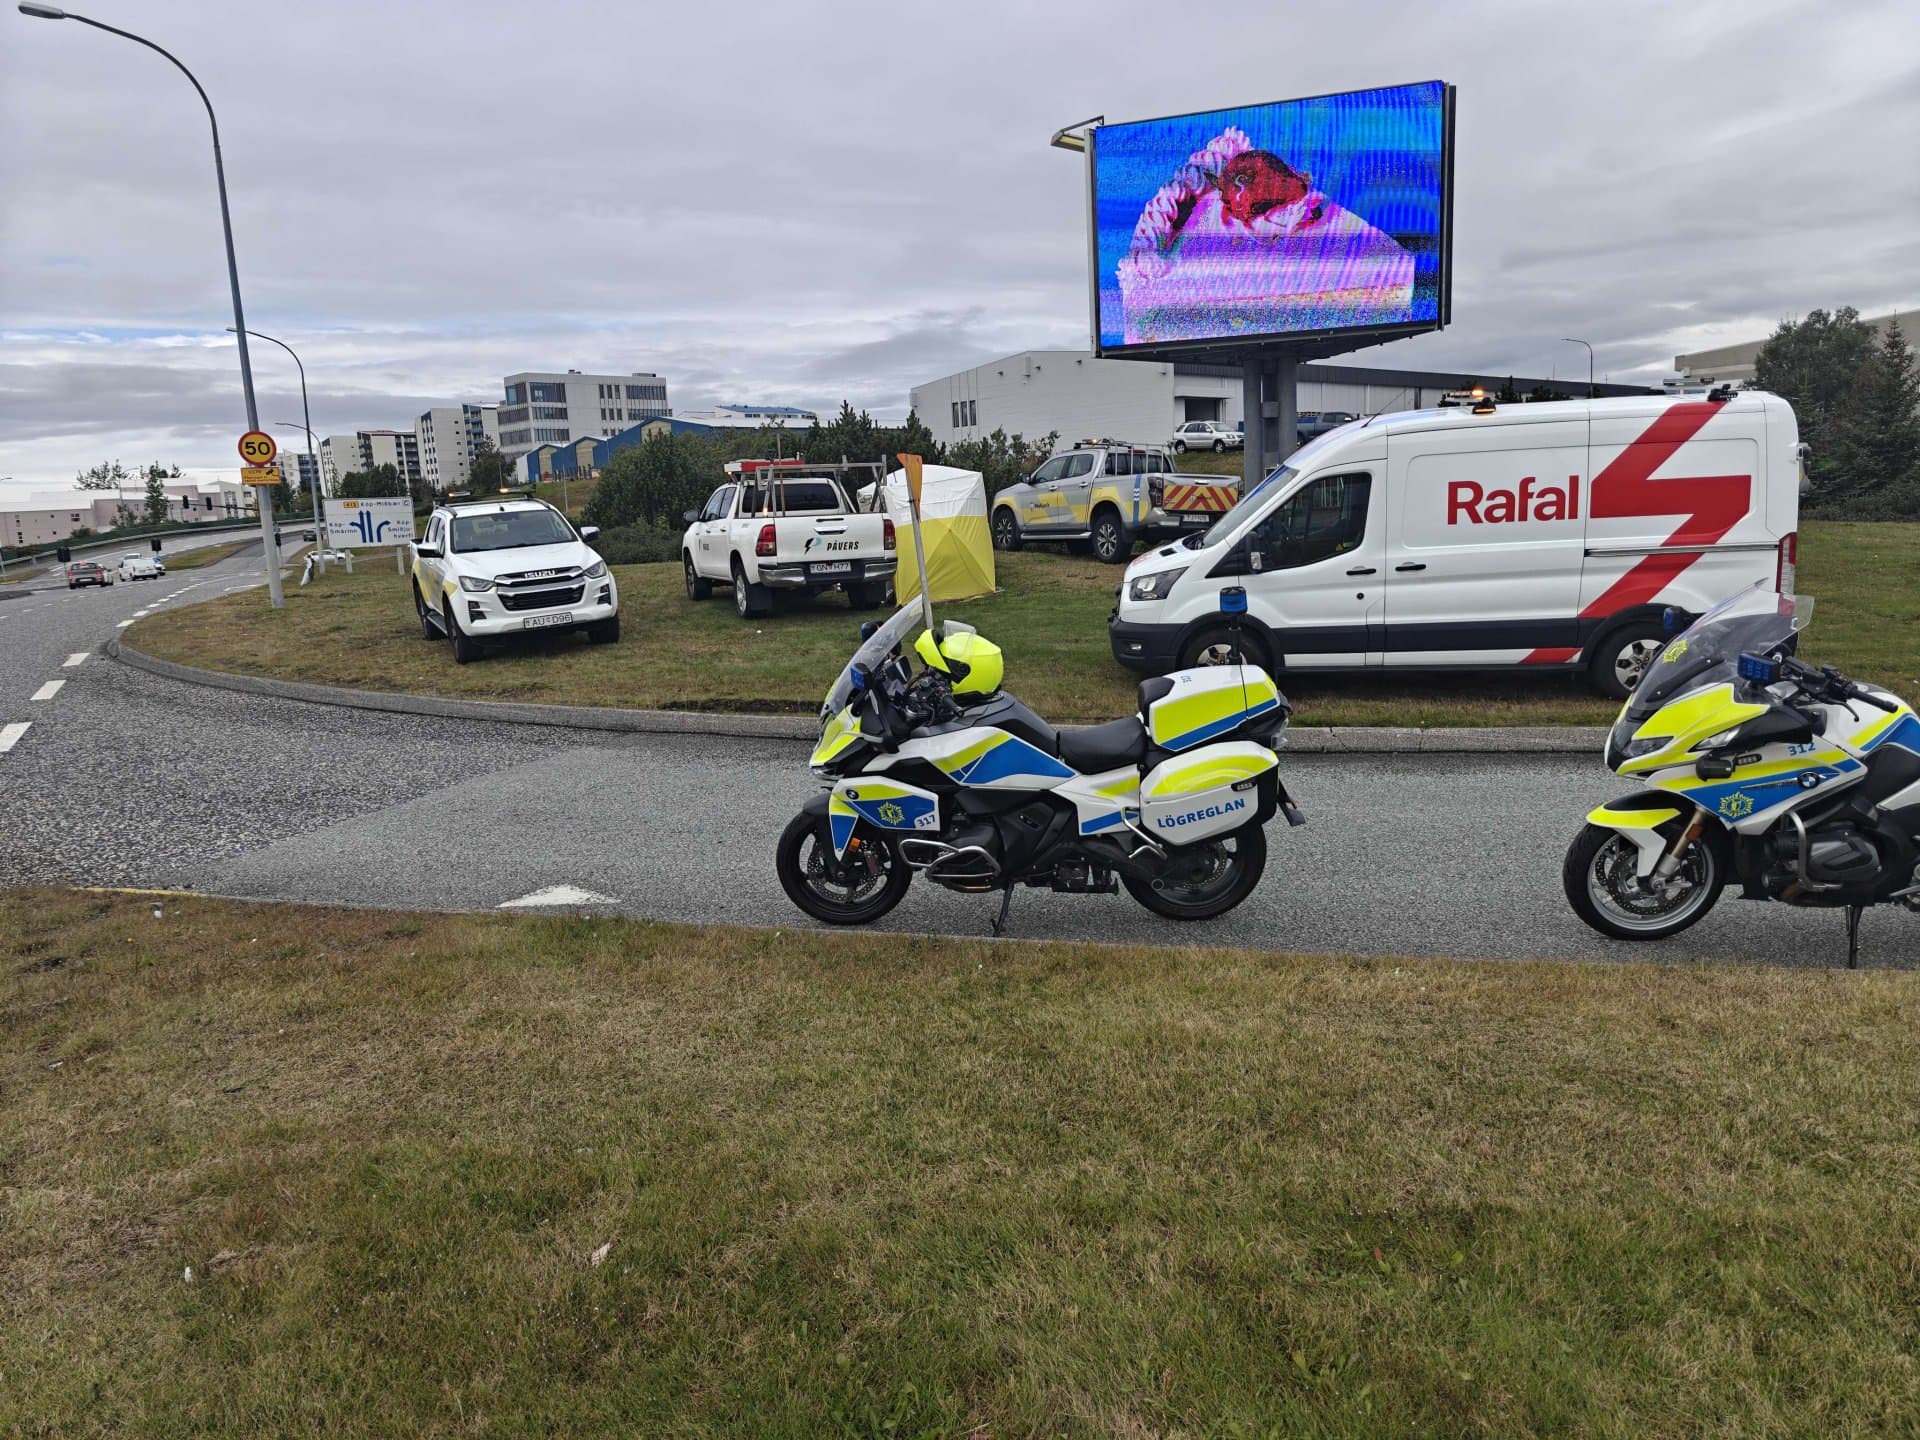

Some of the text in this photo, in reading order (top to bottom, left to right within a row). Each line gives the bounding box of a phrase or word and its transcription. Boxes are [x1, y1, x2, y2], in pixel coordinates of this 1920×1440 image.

[245, 441, 270, 455] 50
[1448, 475, 1579, 525] Rafal
[827, 540, 859, 551] PÁVERS
[524, 570, 555, 578] ISUZU
[1788, 742, 1816, 756] 312
[1157, 798, 1245, 828] LÖGREGLAN
[916, 815, 936, 827] 317
